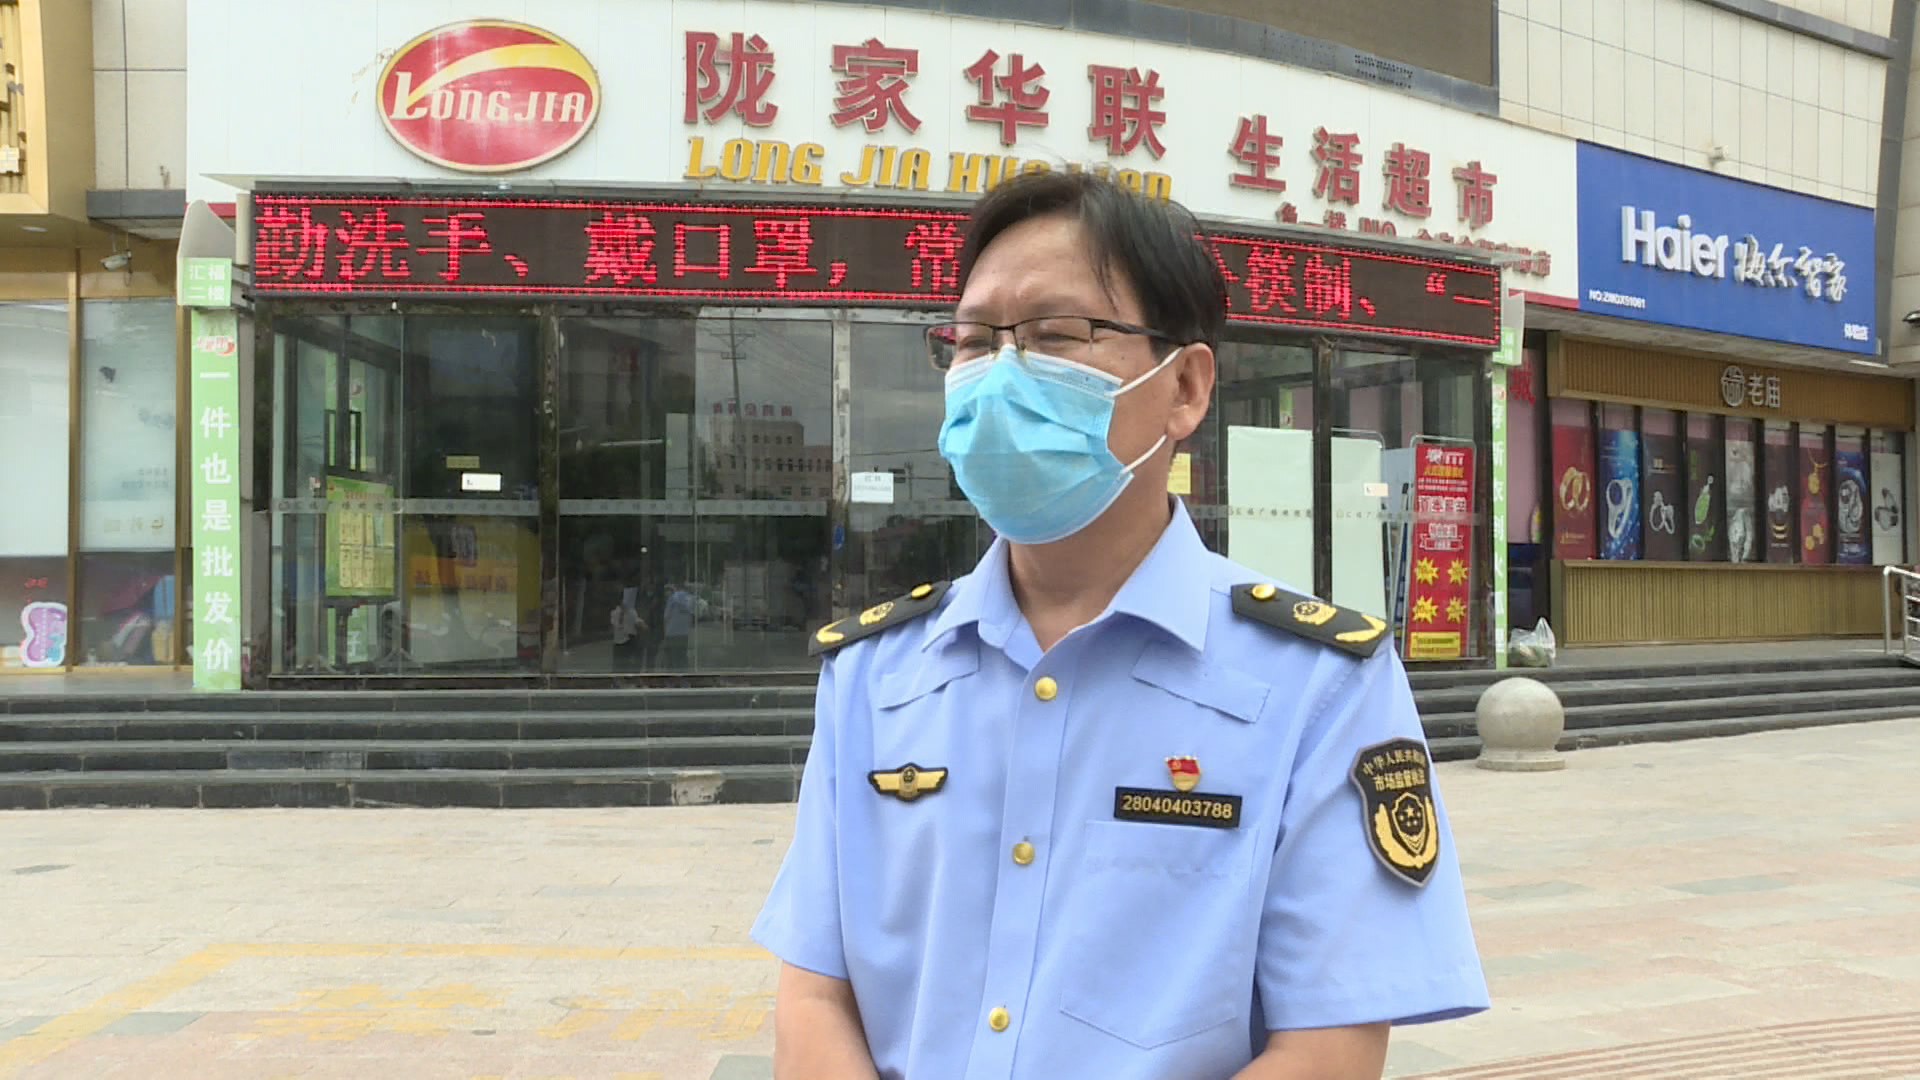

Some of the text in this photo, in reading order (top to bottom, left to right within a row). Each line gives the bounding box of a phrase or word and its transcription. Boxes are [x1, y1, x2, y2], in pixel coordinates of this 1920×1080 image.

[684, 30, 1168, 160] 陇家华联
[683, 136, 825, 185] LONG
[840, 144, 931, 191] JIA
[1227, 114, 1498, 231] 生活超市
[1622, 205, 1730, 279] Haier
[1748, 372, 1781, 408] 老庙
[199, 371, 233, 672] 一件也是批发价
[1122, 795, 1233, 819] 28040403788
